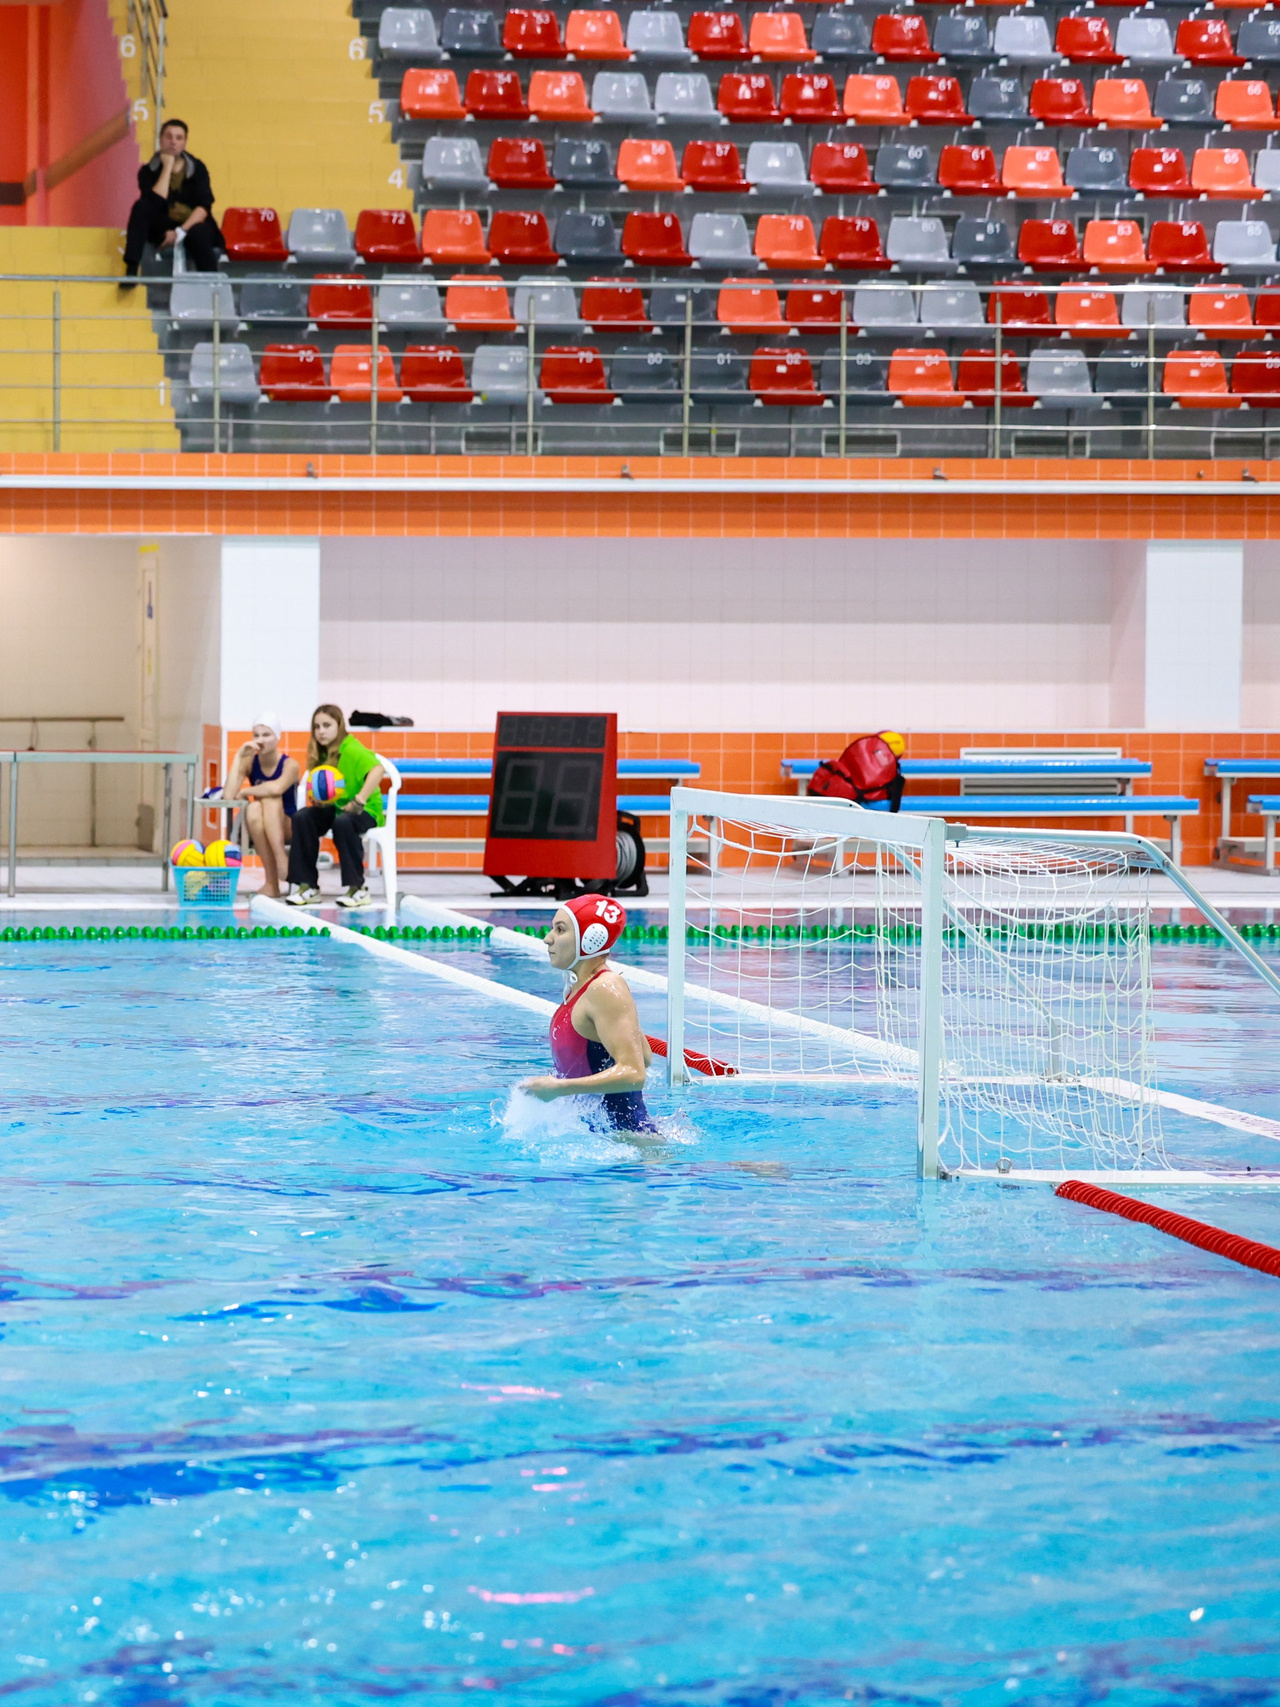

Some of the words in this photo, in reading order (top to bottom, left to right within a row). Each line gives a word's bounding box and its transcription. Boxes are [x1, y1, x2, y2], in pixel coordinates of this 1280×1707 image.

[120, 34, 136, 58] 6
[348, 38, 365, 61] 6
[938, 78, 952, 91] 61
[1000, 79, 1014, 92] 62
[1124, 82, 1138, 94] 64
[134, 98, 148, 121] 5
[368, 101, 383, 123] 5
[908, 146, 923, 159] 60
[971, 148, 985, 161] 61
[1161, 151, 1177, 164] 64
[387, 168, 404, 189] 4
[260, 210, 274, 222] 70
[391, 211, 406, 225] 72
[523, 214, 538, 226] 74
[1051, 222, 1067, 236] 82
[1182, 223, 1197, 236] 84
[157, 380, 165, 406] 1
[595, 899, 621, 924] 13
